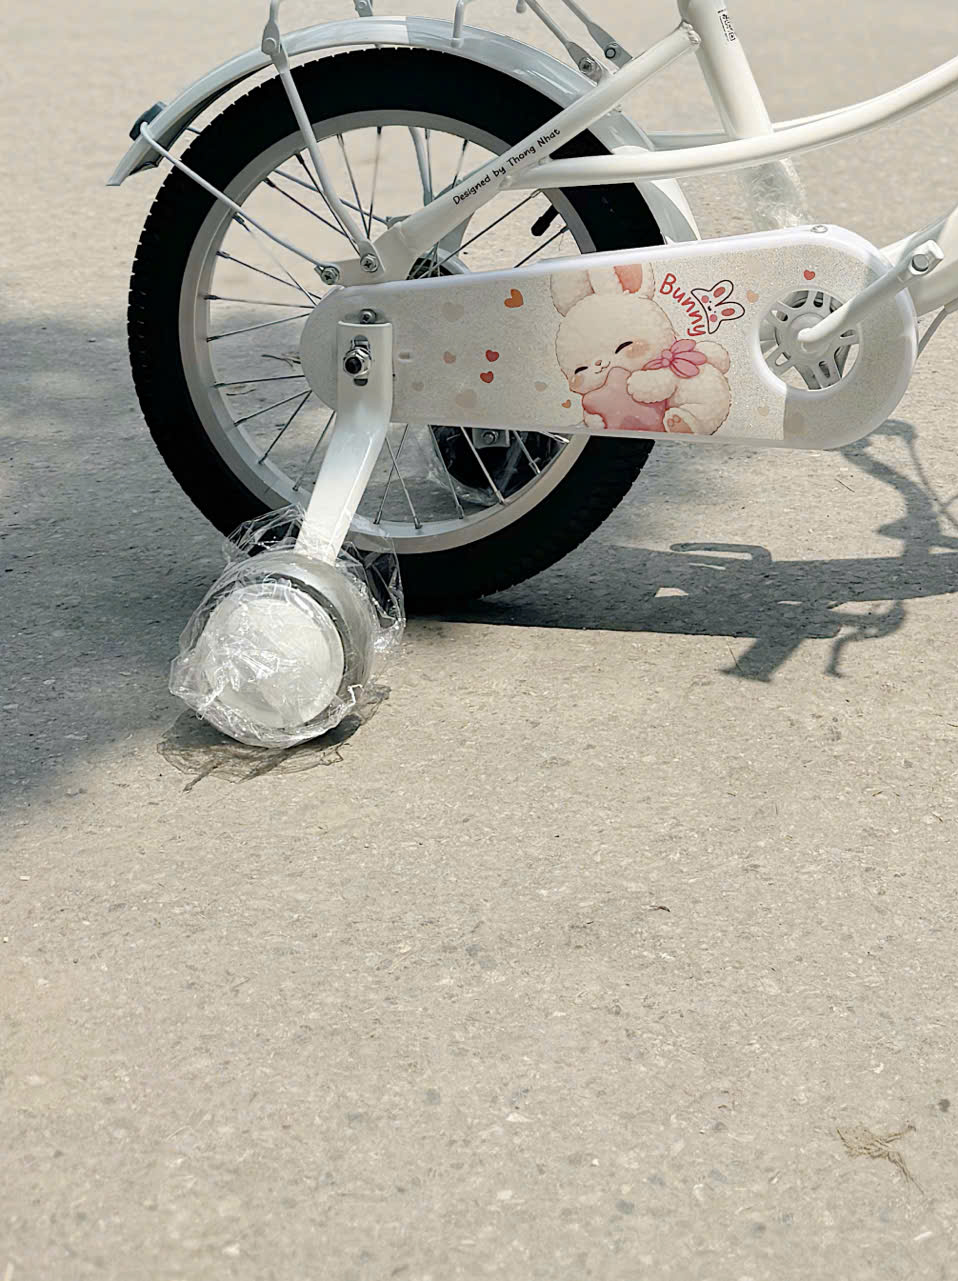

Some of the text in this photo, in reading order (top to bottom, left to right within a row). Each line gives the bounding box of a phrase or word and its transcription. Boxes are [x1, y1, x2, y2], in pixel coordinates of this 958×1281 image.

[452, 128, 561, 205] Designed by Thong Nhat
[659, 273, 707, 337] Bunny
